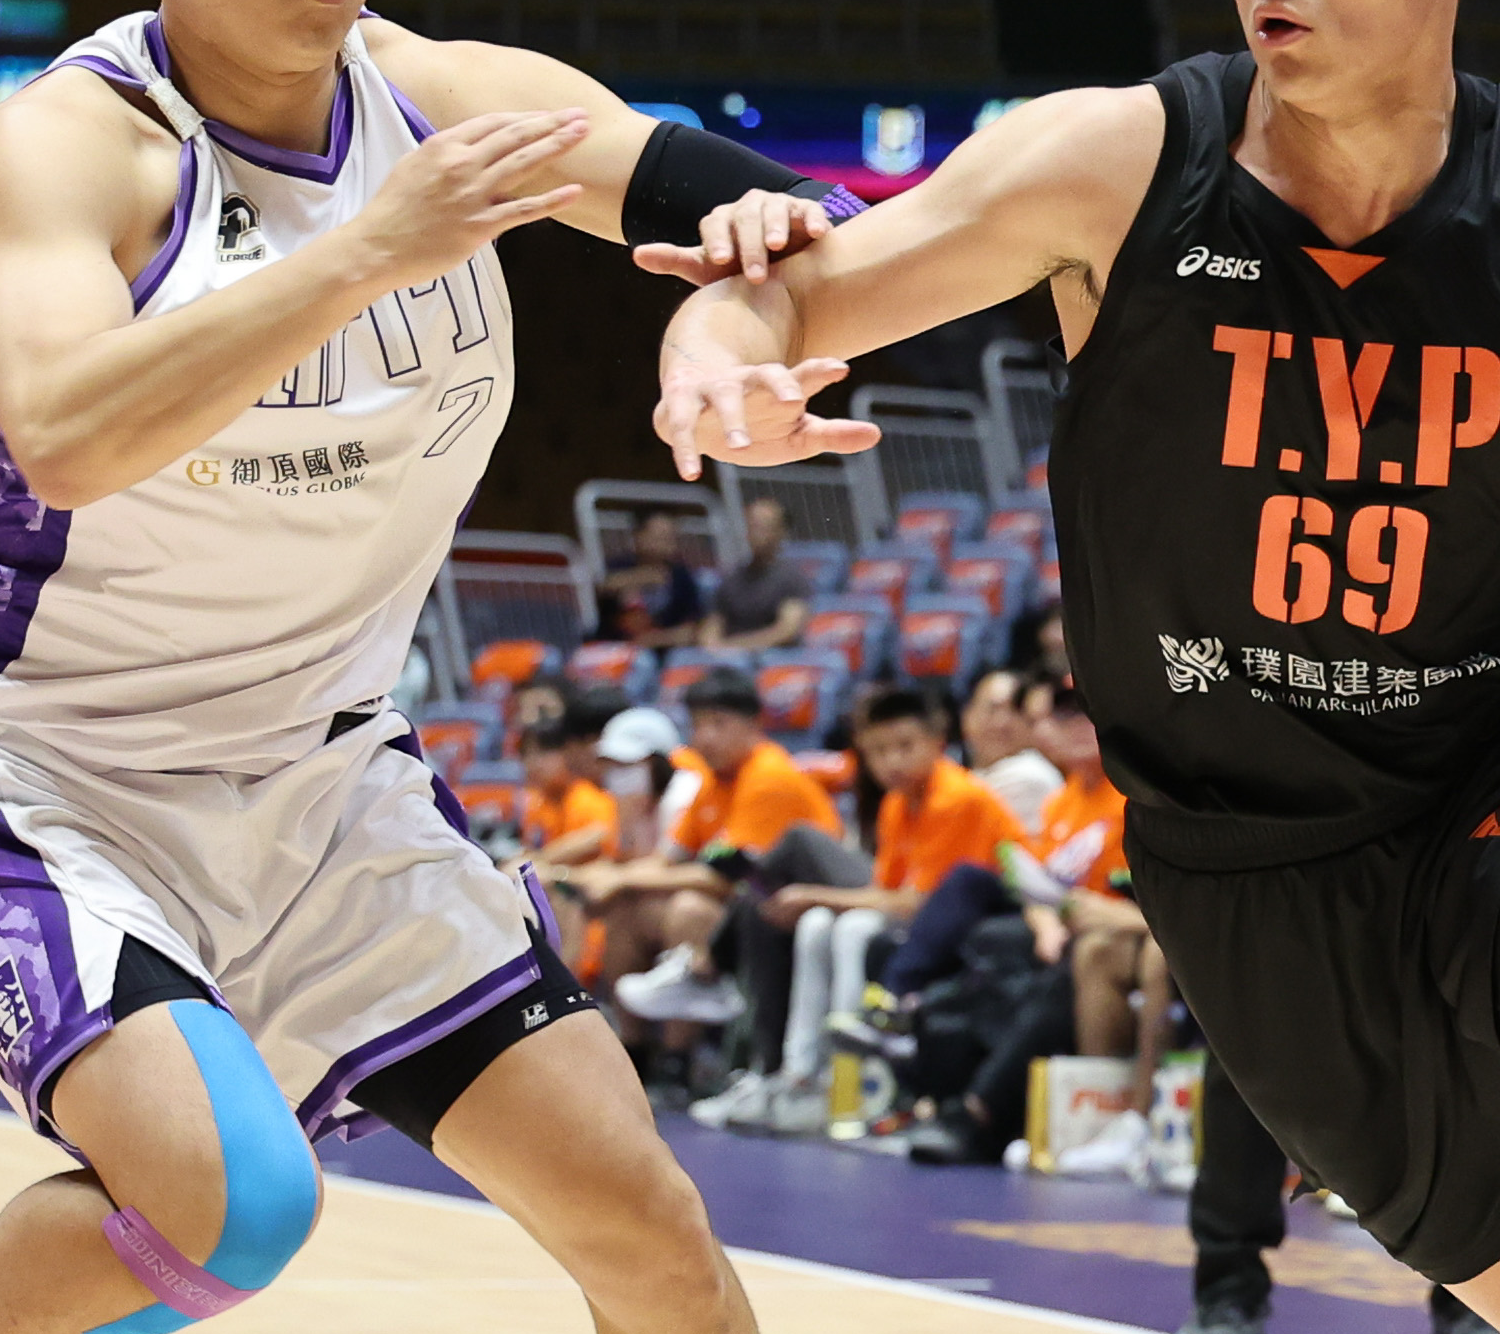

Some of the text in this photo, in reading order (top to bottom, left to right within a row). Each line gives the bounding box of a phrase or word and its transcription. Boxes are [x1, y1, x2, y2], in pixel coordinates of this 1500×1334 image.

[422, 376, 494, 459] 7
[231, 440, 370, 485] 御頂國際
[1252, 495, 1430, 635] 69
